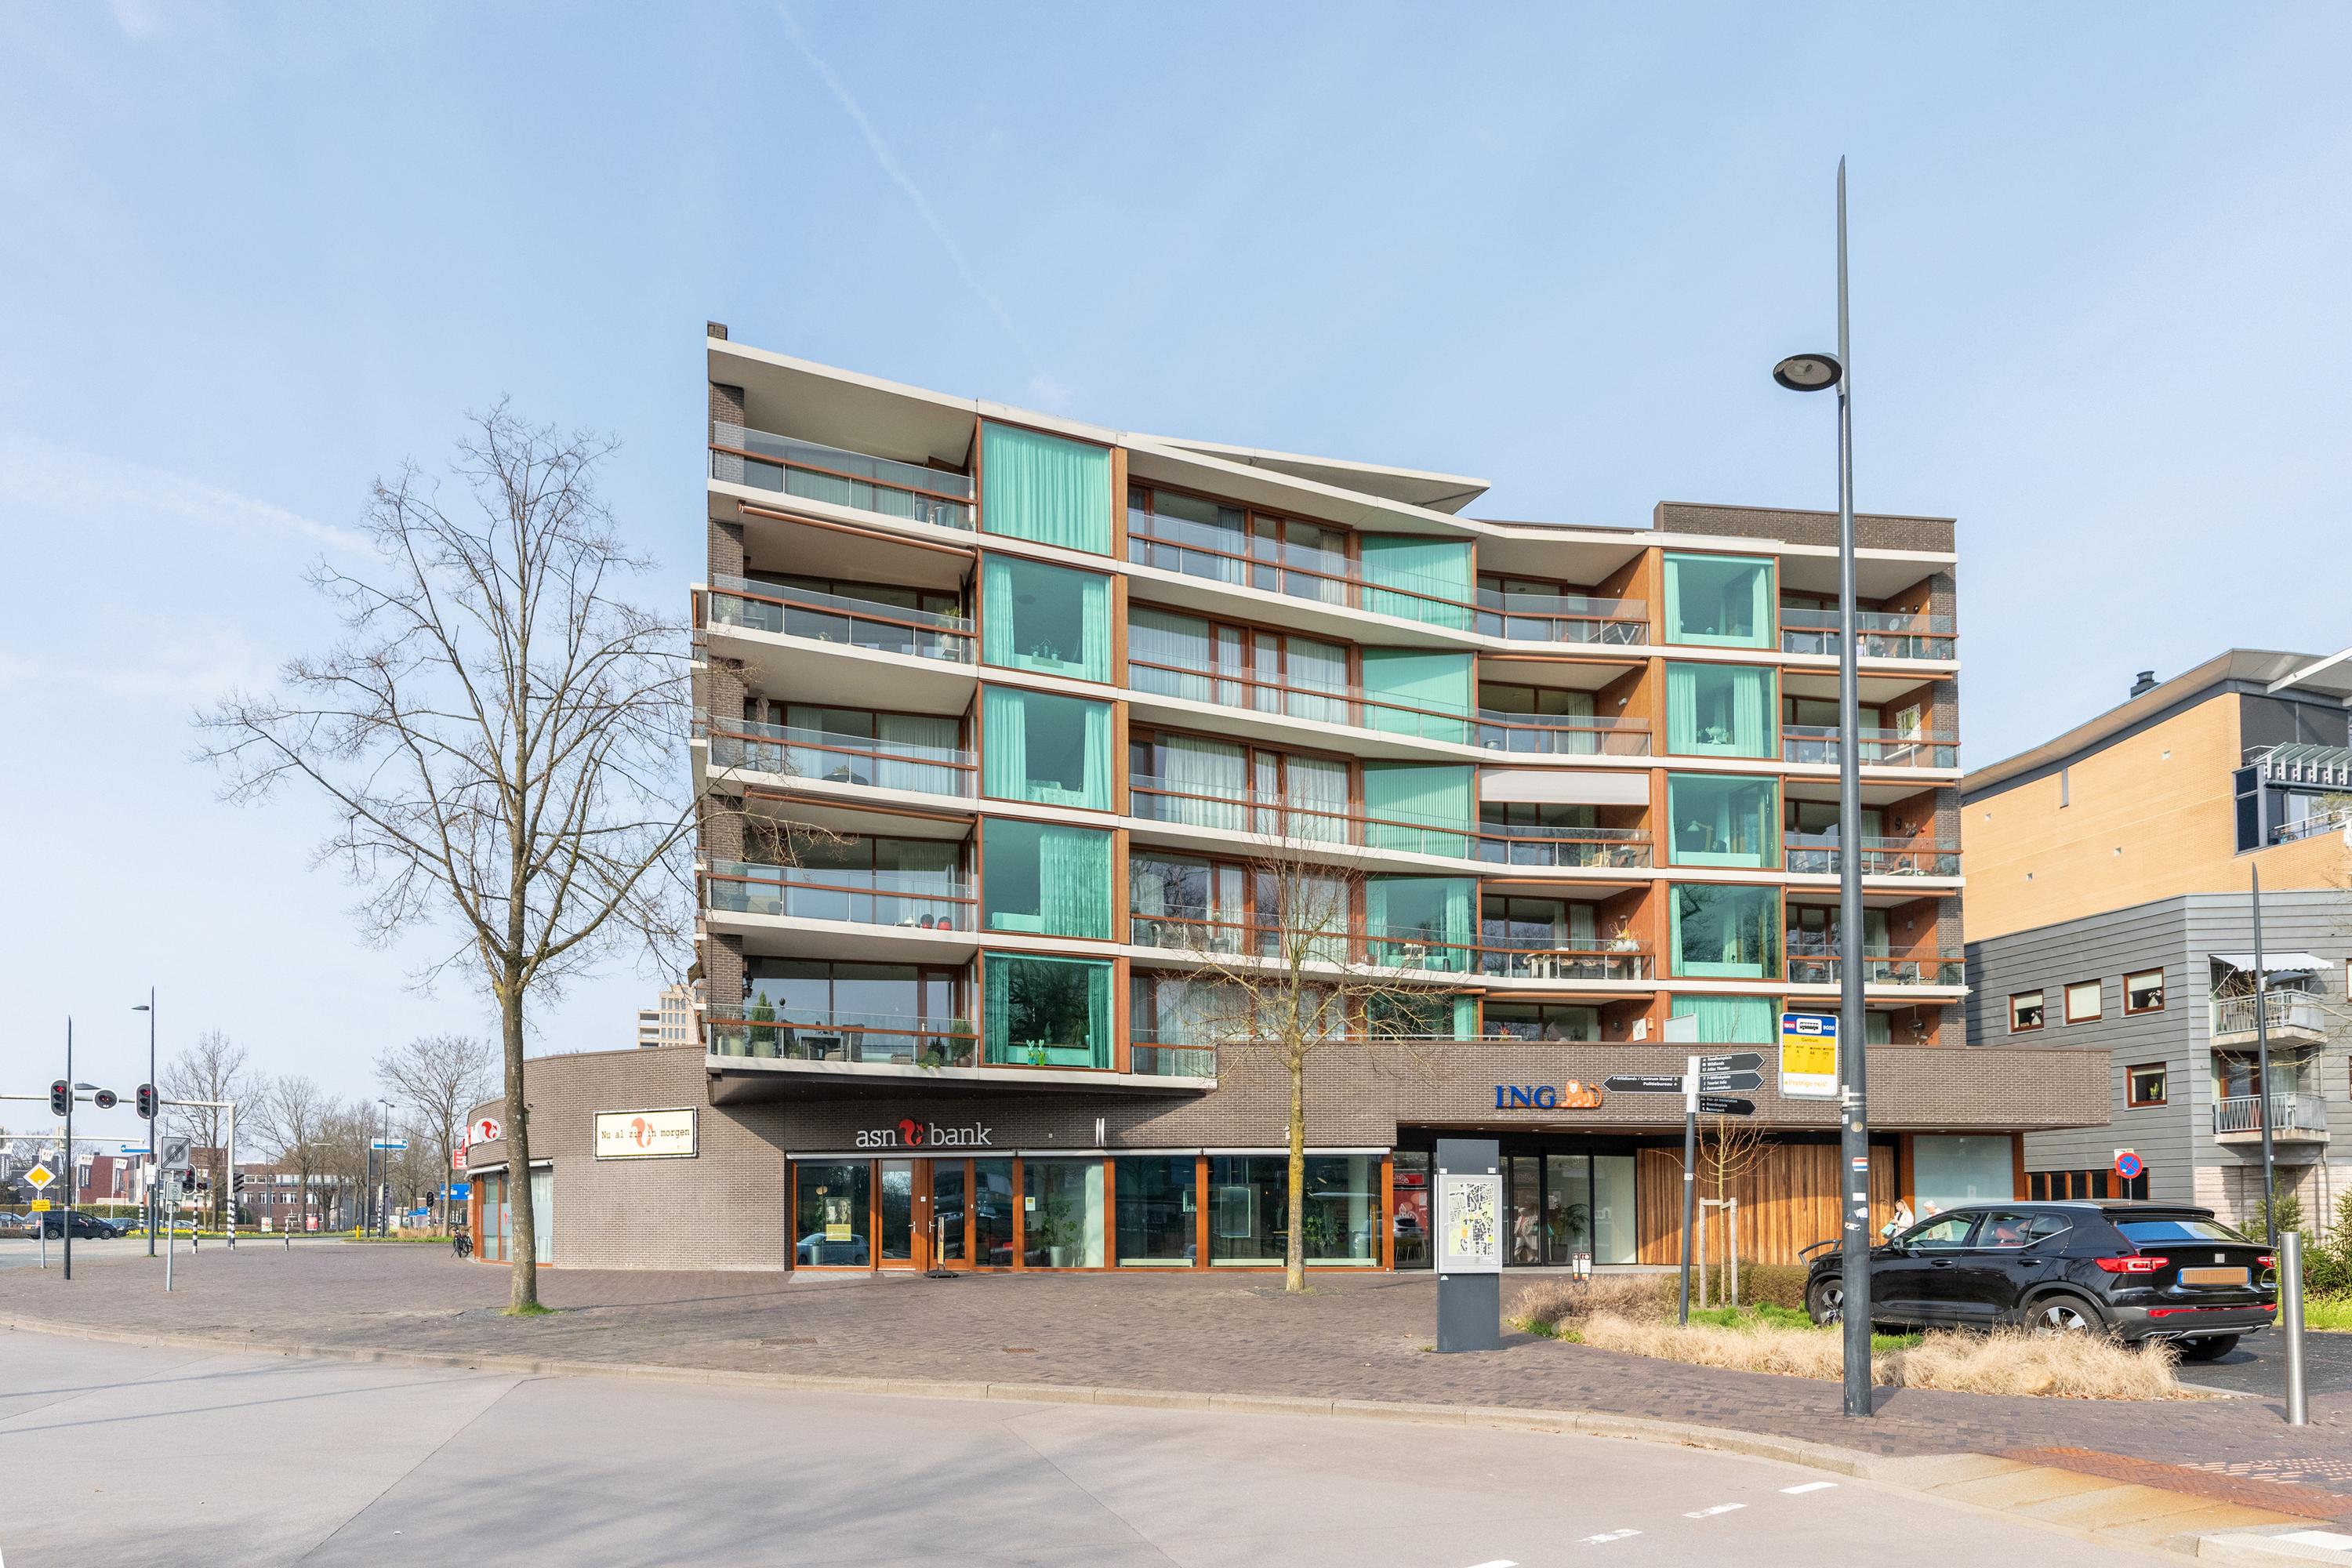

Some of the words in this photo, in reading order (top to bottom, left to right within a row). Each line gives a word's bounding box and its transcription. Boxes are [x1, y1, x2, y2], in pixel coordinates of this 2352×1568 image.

[1495, 1085, 1556, 1109] ING
[601, 1131, 611, 1139] Nu
[615, 1130, 624, 1138] al
[660, 1129, 690, 1139] morgen
[855, 1129, 898, 1147] asn
[929, 1122, 993, 1146] bank
